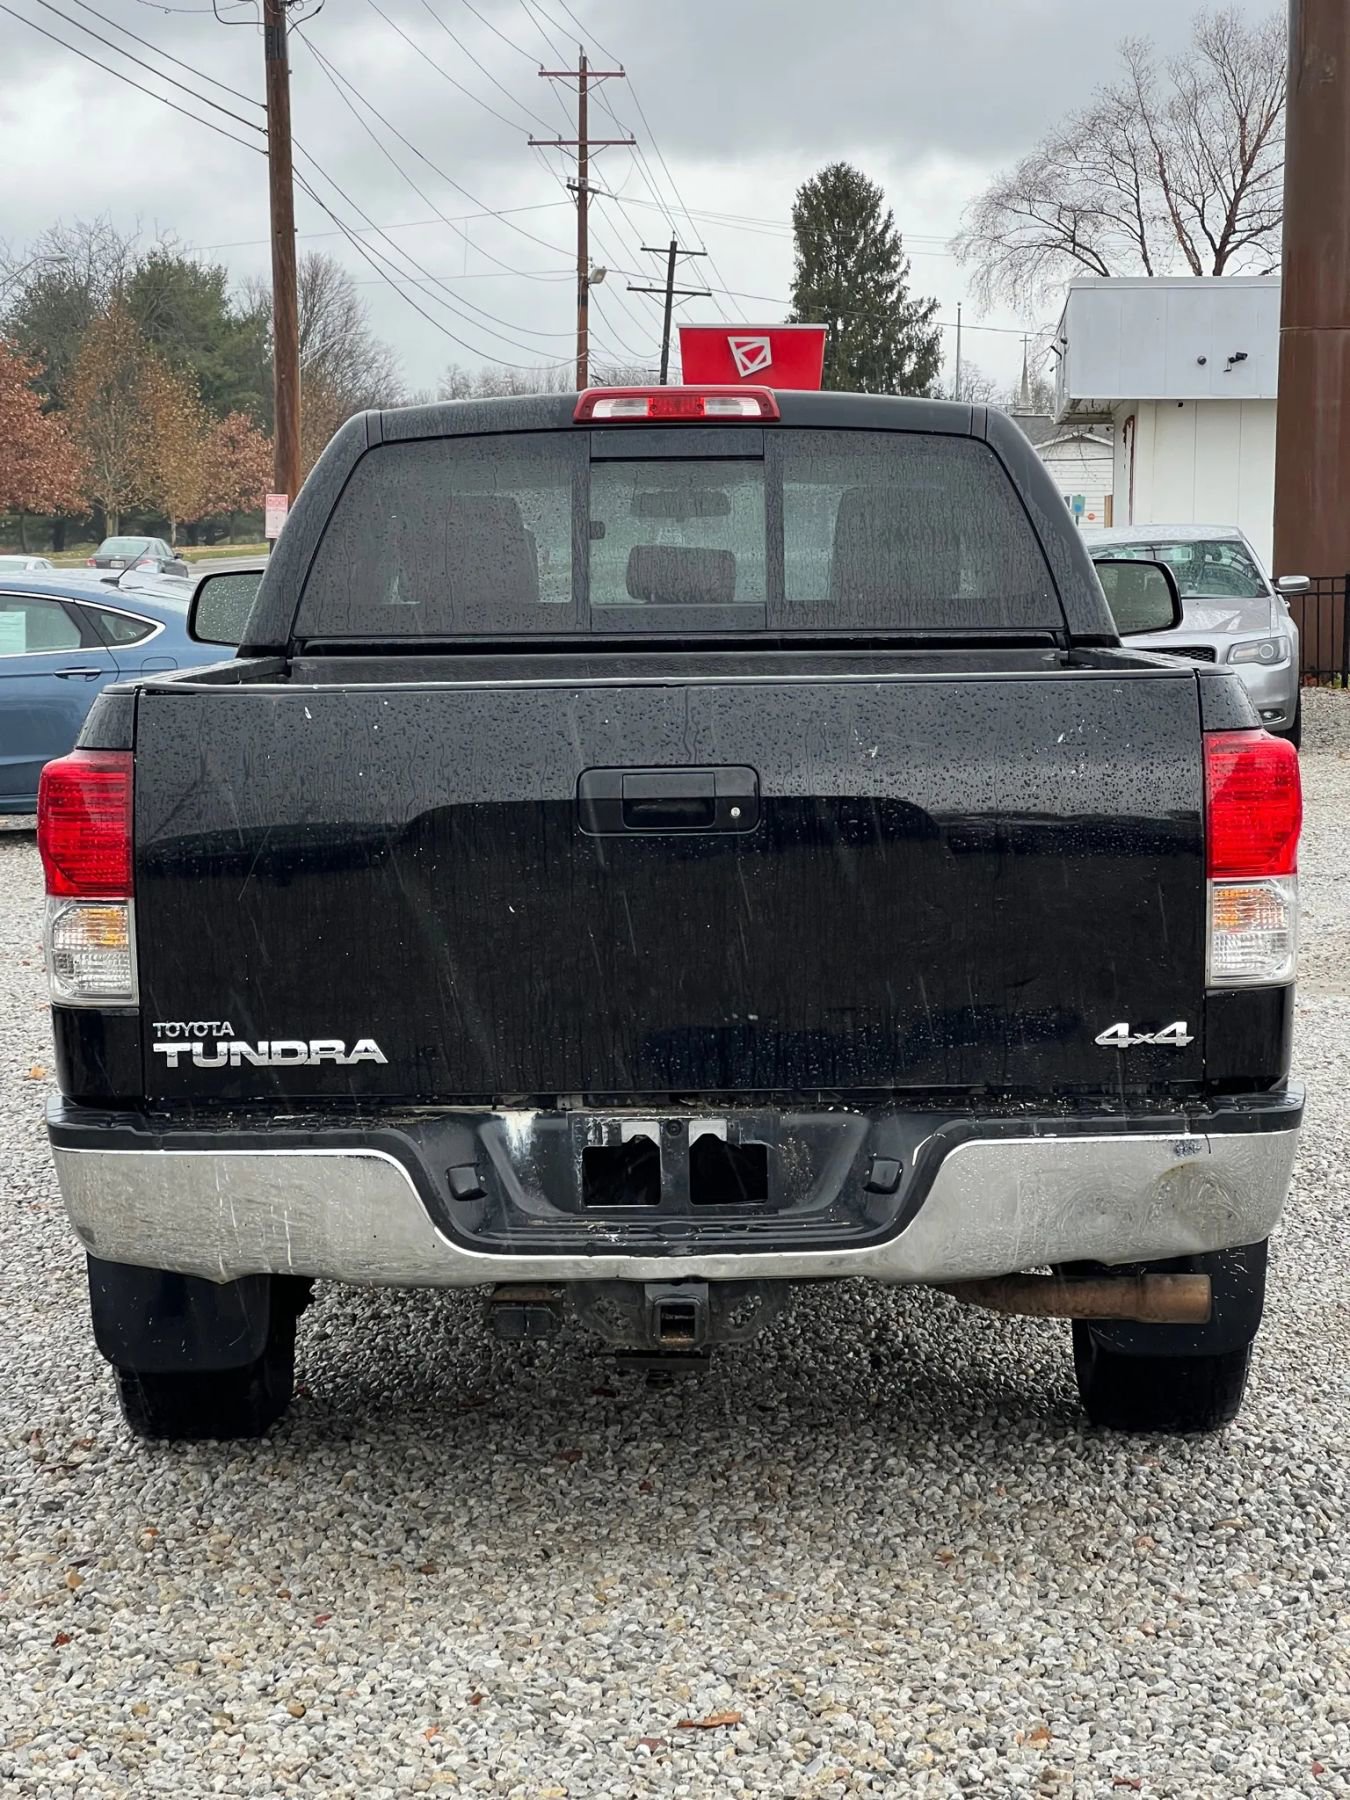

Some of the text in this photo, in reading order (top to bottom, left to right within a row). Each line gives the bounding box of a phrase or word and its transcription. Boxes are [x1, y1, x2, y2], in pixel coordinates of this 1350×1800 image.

[152, 1021, 235, 1037] TOYOTA
[1094, 1021, 1195, 1048] 4x4
[152, 1038, 389, 1068] TUNDRA
